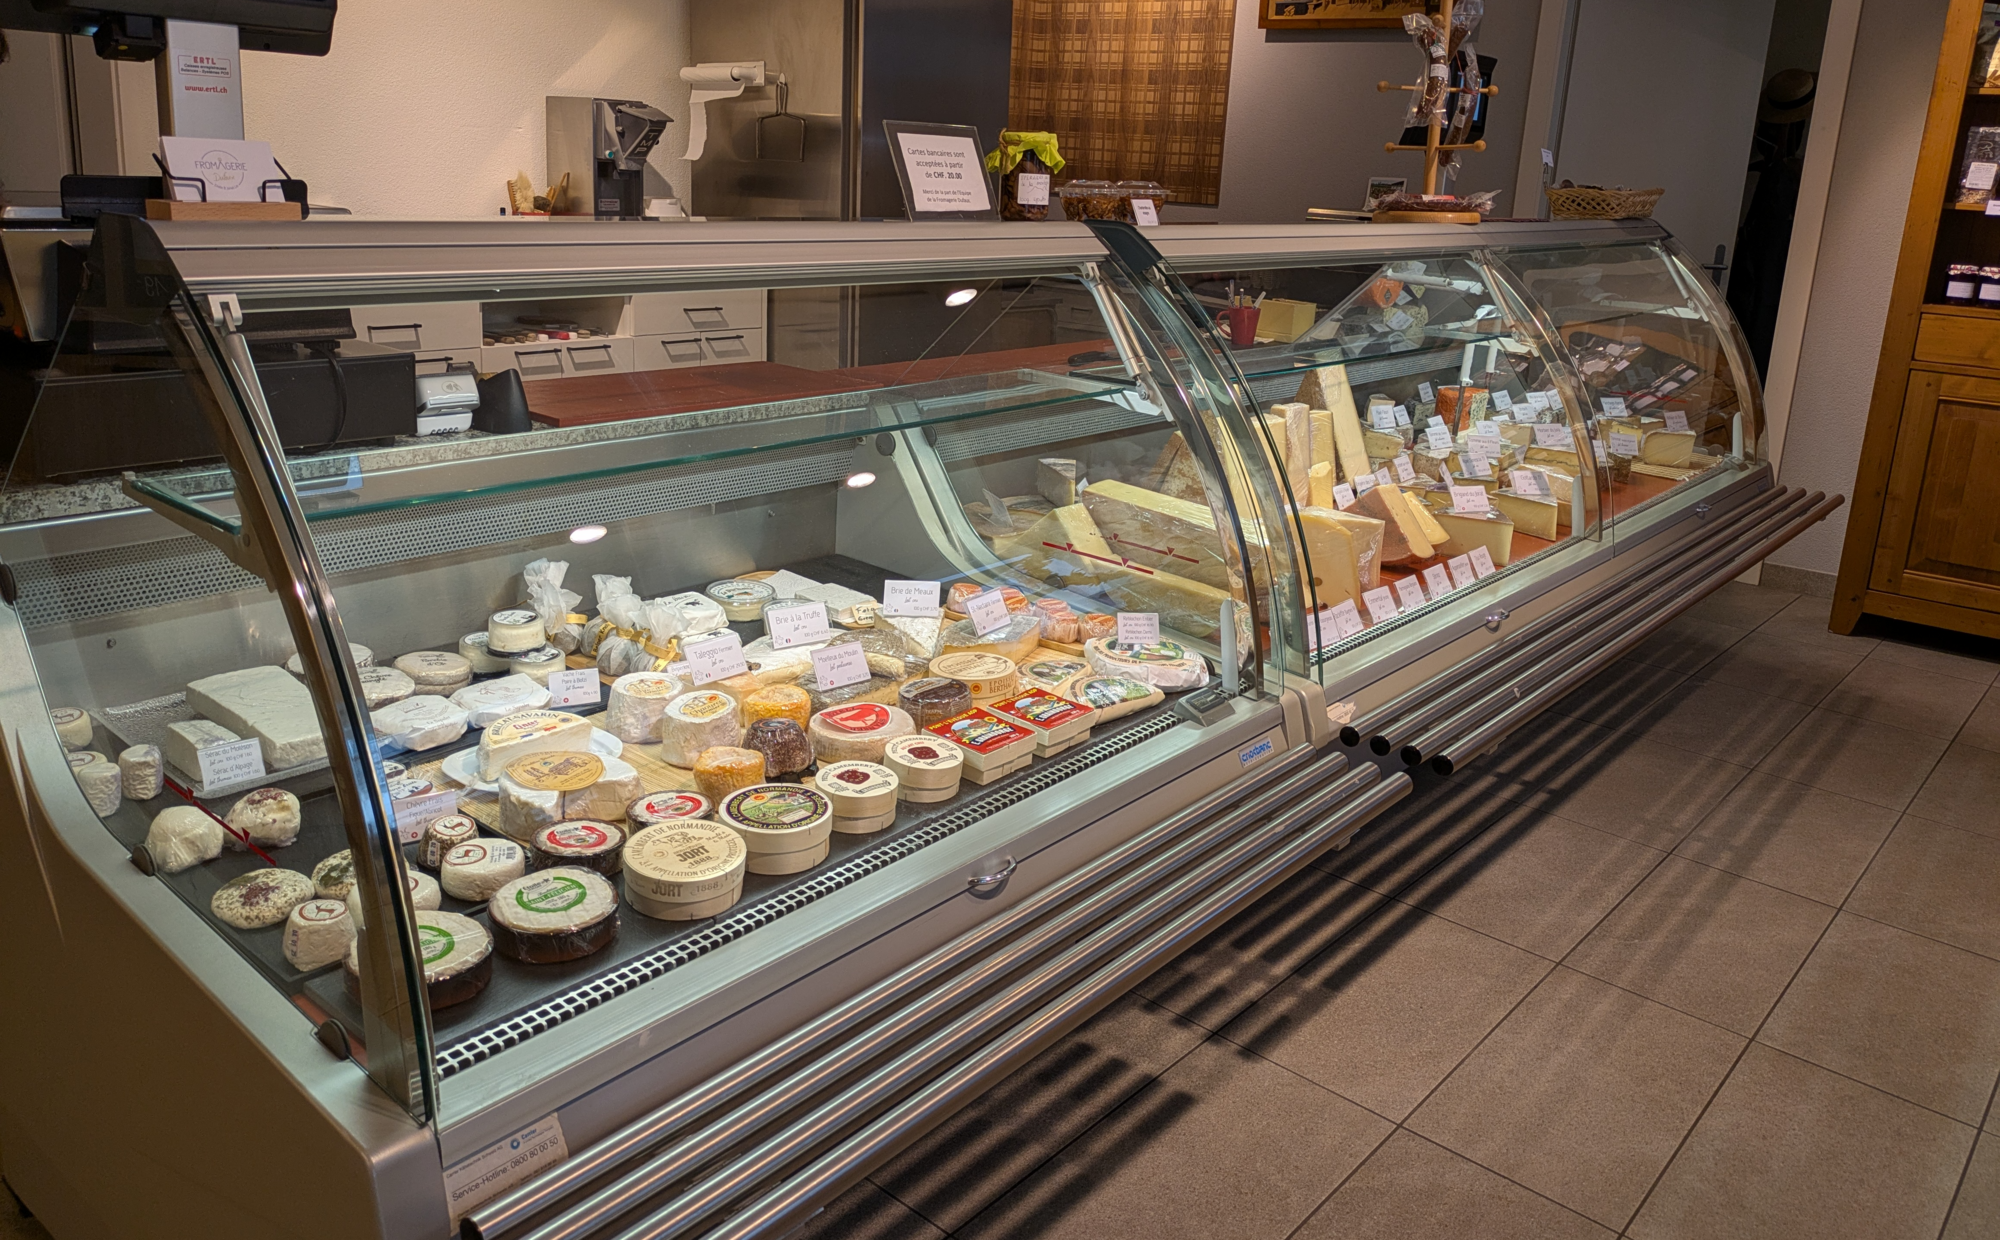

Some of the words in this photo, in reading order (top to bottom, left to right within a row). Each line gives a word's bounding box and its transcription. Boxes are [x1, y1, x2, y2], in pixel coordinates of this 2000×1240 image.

[193, 56, 216, 65] ERTL
[184, 86, 228, 94] www.ertl.ch
[908, 148, 926, 156] Cartes
[926, 148, 953, 158] bancaires
[194, 157, 248, 171] FROMAGERIE
[916, 160, 944, 168] acceptées
[891, 586, 904, 594] Brie
[775, 616, 788, 625] Brie
[790, 612, 794, 622] à
[796, 613, 802, 621] la
[802, 610, 820, 620] Truffe
[694, 648, 718, 660] Taleggio
[844, 649, 858, 657] Moulin
[492, 712, 560, 736] BRILLAT-SAVARIN
[204, 750, 221, 758] Sérac
[222, 746, 230, 754] du
[230, 743, 252, 752] Moléson
[212, 768, 228, 776] Sérac
[230, 762, 253, 772] d'Alpage
[830, 764, 875, 772] CAMEMBERT
[747, 788, 756, 796] DE
[758, 786, 805, 794] NORMANDIE
[406, 800, 427, 810] Chèvre
[428, 797, 444, 806] Frais
[653, 826, 668, 836] DE
[665, 822, 720, 833] NORMANDIE
[742, 820, 790, 830] APPELLATION
[675, 844, 710, 863] JORT
[688, 855, 713, 868] 1888
[650, 866, 699, 877] APPELLATION
[651, 882, 684, 898] JORT
[695, 881, 720, 893] 1888
[521, 1128, 538, 1140] Carrier
[452, 1164, 510, 1202] Service-Hotline:
[510, 1153, 529, 1170] 0800
[529, 1148, 539, 1159] 80
[539, 1142, 549, 1153] 00
[550, 1136, 559, 1147] 50
